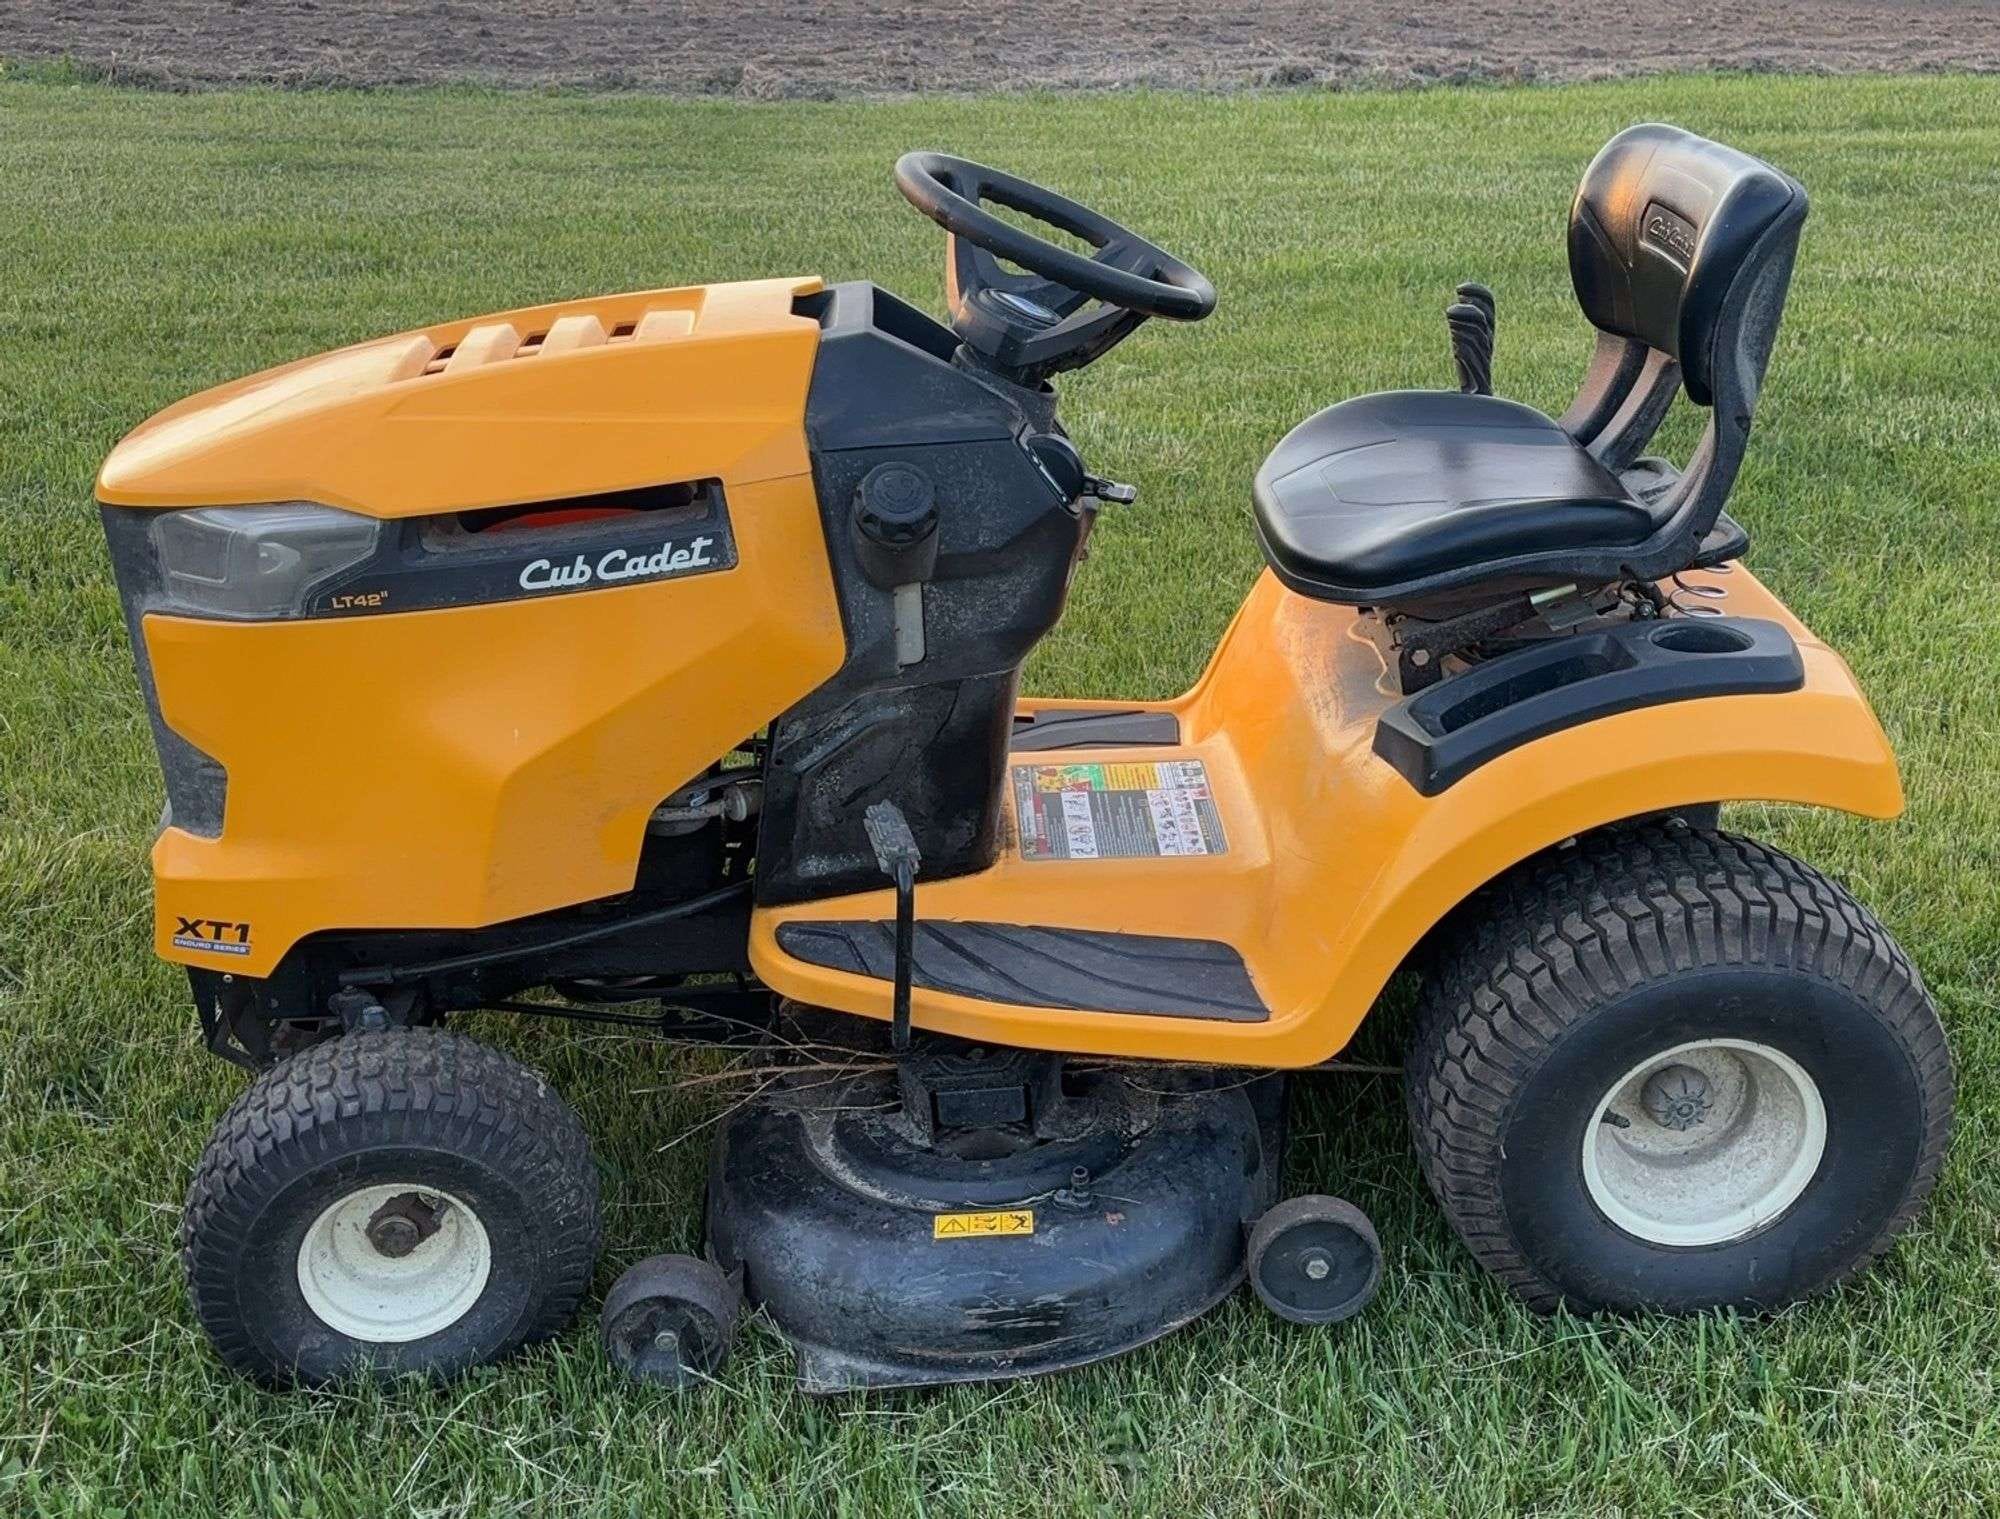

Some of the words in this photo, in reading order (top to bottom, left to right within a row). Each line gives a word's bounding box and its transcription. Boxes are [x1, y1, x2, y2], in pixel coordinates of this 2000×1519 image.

[519, 555, 592, 590] Cub
[596, 537, 713, 580] Cadet
[331, 590, 388, 609] LT42"
[174, 916, 250, 943] XT1
[213, 944, 248, 954] SERIES
